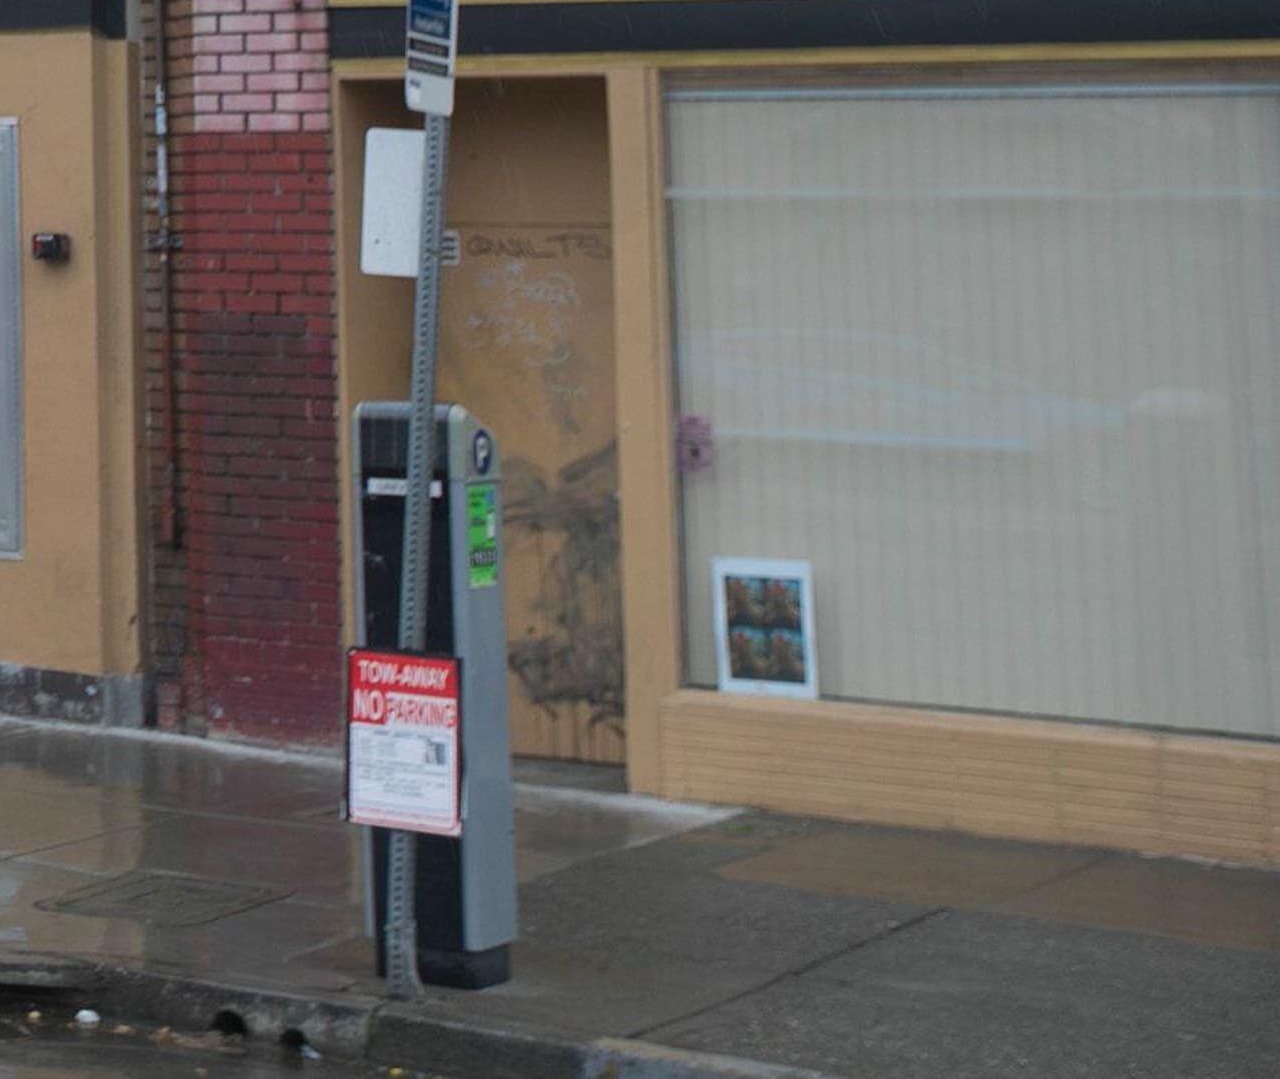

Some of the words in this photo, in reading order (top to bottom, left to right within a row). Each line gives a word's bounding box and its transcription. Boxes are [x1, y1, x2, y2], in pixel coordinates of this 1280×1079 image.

[358, 659, 450, 691] TOW-AWAY
[352, 688, 384, 721] NO
[386, 691, 458, 729] PARKING
